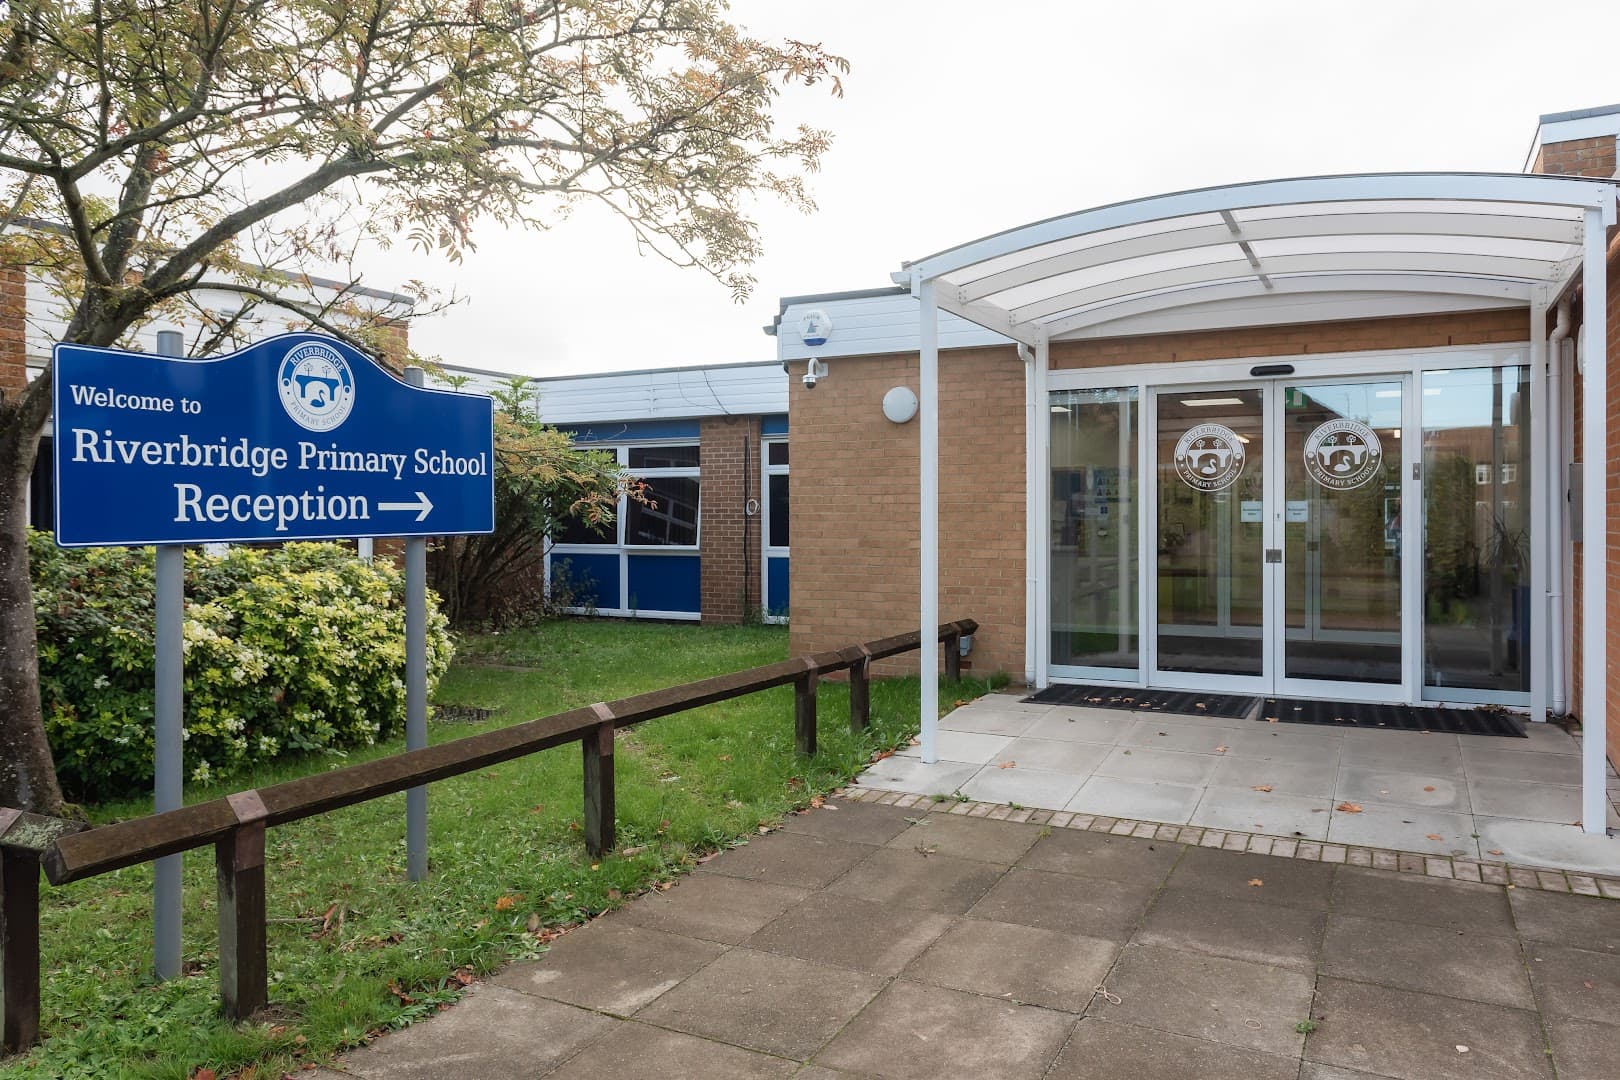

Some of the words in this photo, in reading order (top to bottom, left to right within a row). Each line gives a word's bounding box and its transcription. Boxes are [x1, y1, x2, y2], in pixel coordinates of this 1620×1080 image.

[289, 347, 344, 372] RIVERBRIDGE
[70, 384, 174, 413] Welcome
[181, 397, 202, 414] to
[290, 401, 320, 426] PRIMARY
[320, 406, 346, 426] SCHOOL
[1184, 426, 1233, 444] RIVERBRIDGE
[1314, 422, 1369, 440] RIVERBRIDGE
[71, 428, 288, 477] Riverbridge
[298, 442, 406, 480] Primary
[414, 448, 487, 476] School
[1183, 470, 1212, 488] PRIMARY
[1213, 469, 1237, 487] SCHOOL
[1313, 467, 1345, 486] PRIMARY
[1347, 466, 1373, 485] SCHOOL
[173, 482, 370, 532] Reception
